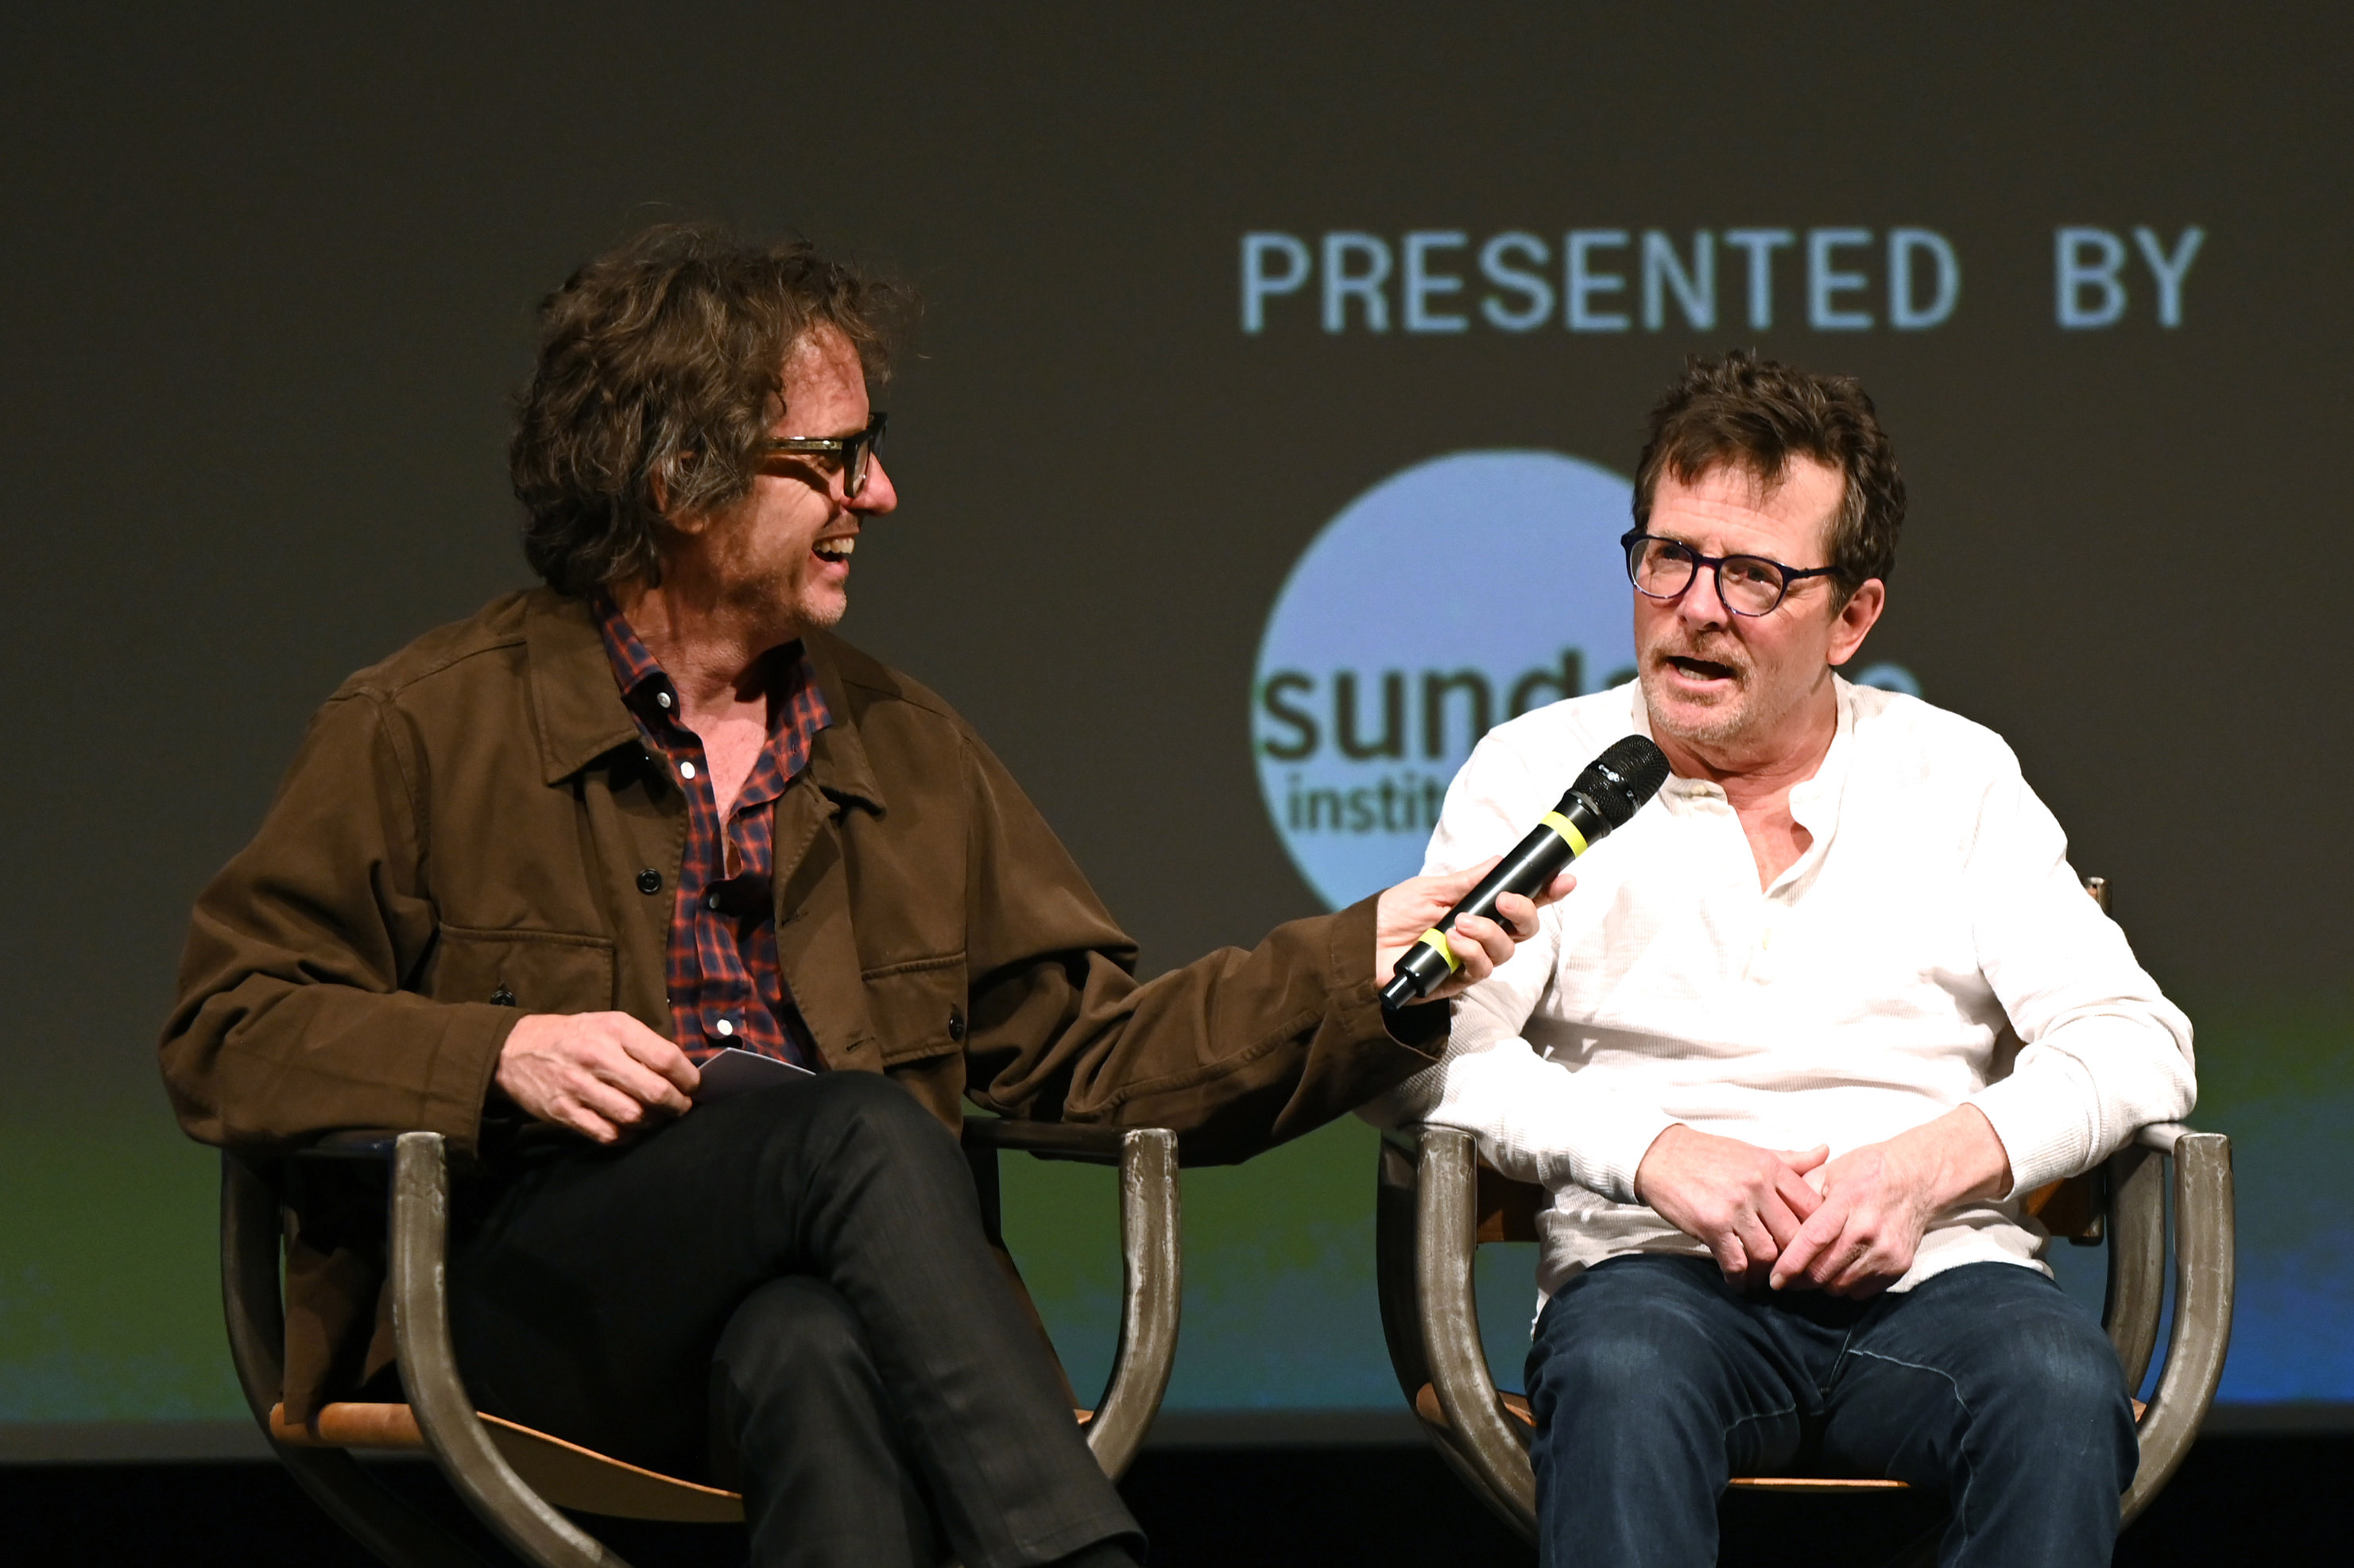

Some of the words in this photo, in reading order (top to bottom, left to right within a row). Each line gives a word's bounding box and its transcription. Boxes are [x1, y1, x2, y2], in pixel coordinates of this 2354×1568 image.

[1241, 228, 1960, 332] PRESENTED
[2055, 226, 2205, 328] BY
[1287, 771, 1446, 832] instit
